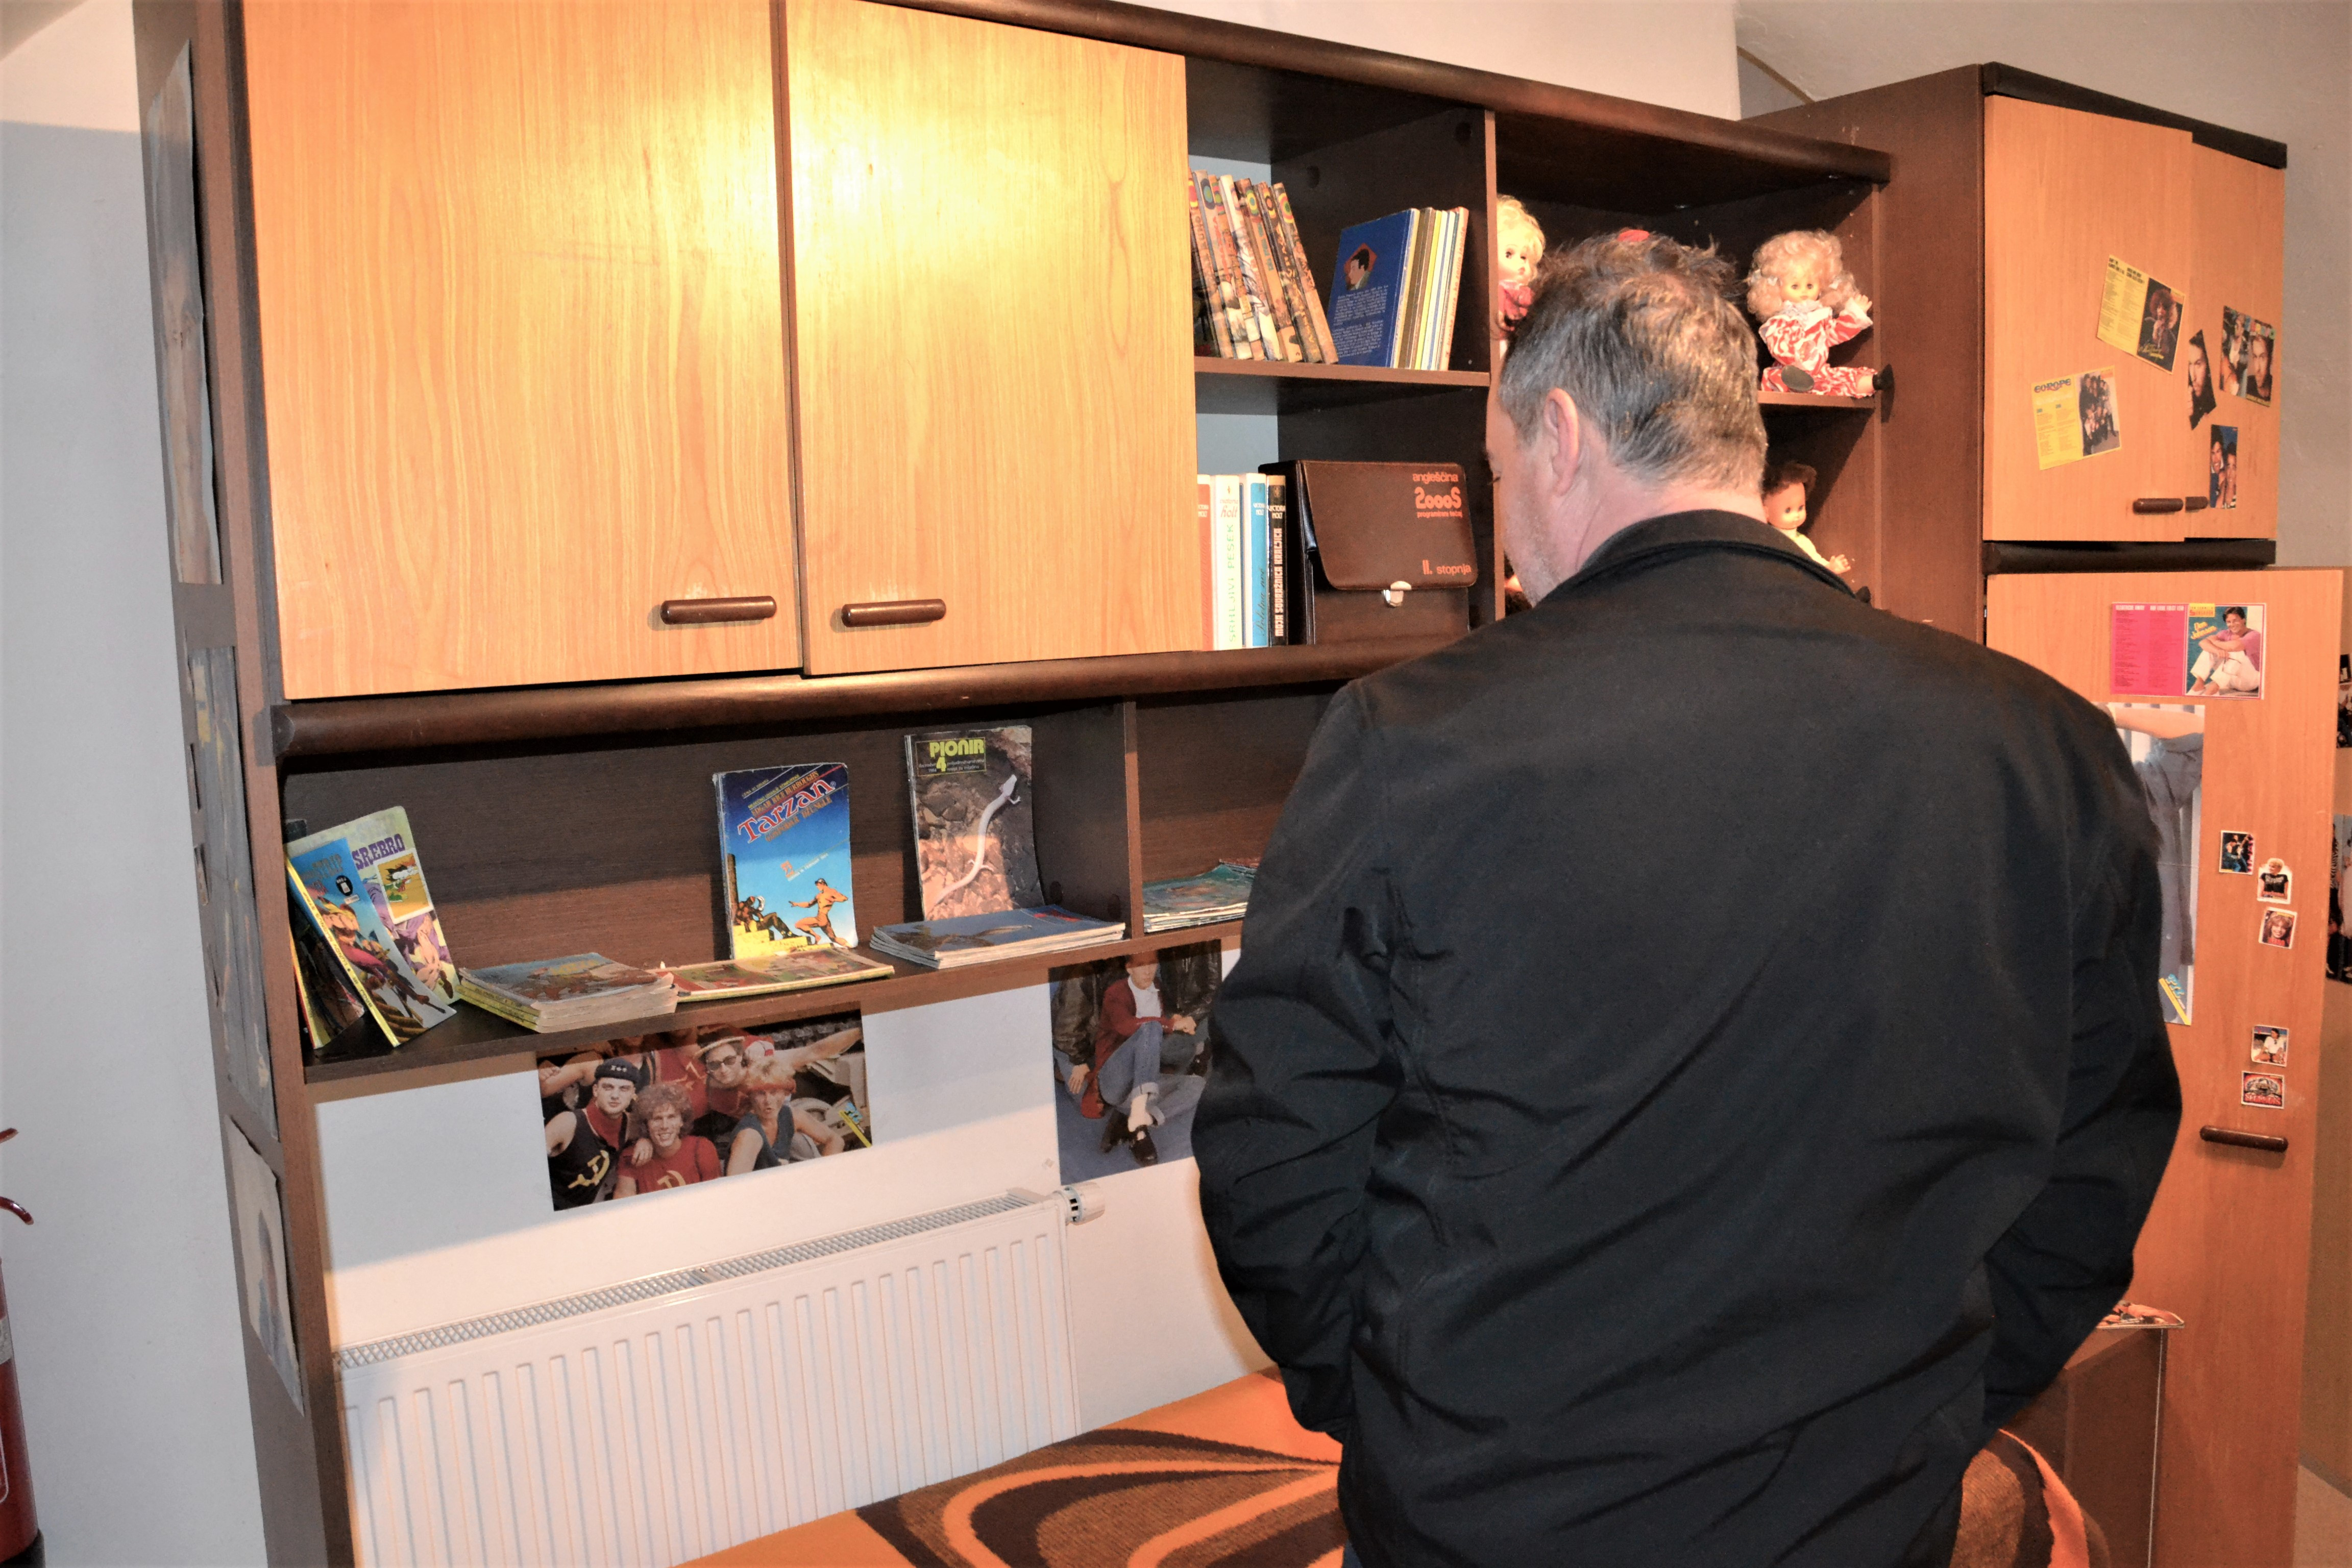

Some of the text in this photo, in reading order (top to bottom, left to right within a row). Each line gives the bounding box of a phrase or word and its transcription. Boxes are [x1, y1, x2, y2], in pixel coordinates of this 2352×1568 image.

[1422, 559, 1472, 576] II. stopnja
[1275, 614, 1284, 637] MOJA
[929, 739, 985, 757] PIONIR
[936, 756, 947, 772] 4
[785, 770, 819, 794] BURROUGHS
[737, 779, 836, 844] Tarzan
[352, 833, 406, 870] SREBRO
